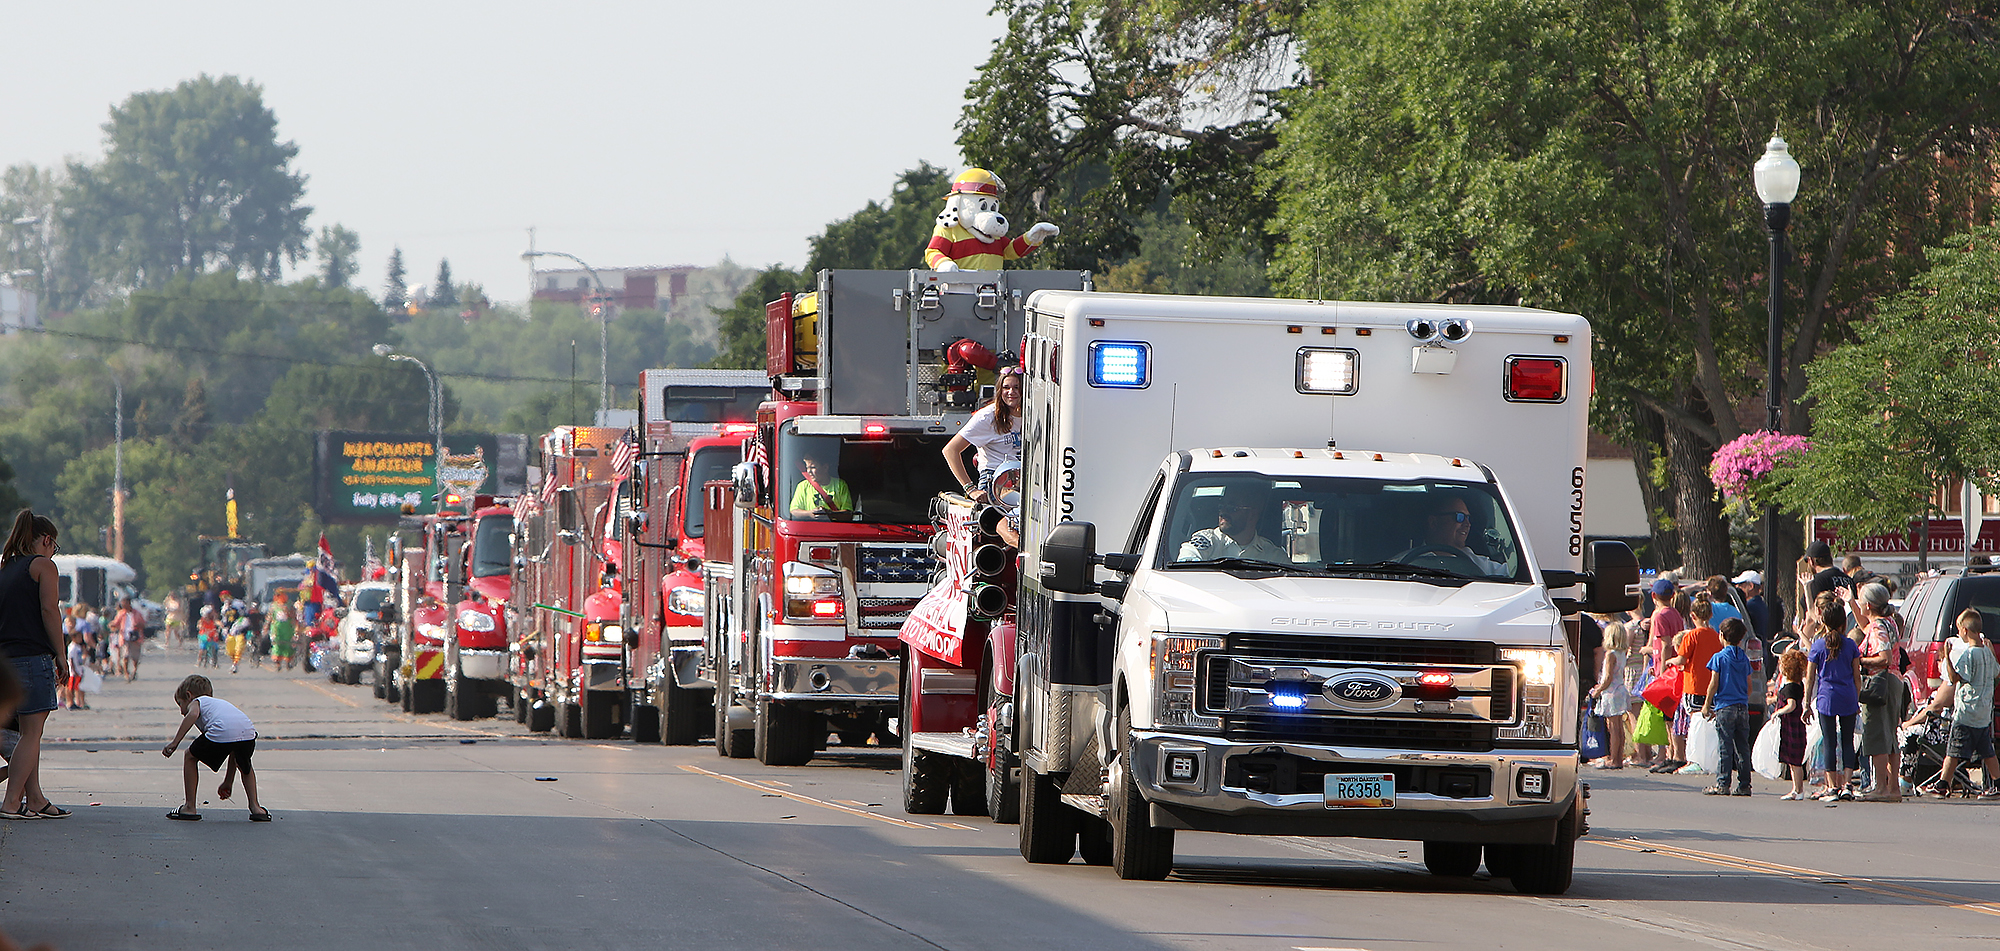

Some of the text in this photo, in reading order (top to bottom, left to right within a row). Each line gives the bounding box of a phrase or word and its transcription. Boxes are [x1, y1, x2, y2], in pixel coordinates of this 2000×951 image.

[352, 458, 423, 472] AMATEUR
[1568, 466, 1584, 556] 6358
[1817, 538, 1911, 551] UTHERAN
[1270, 616, 1455, 632] SUPER DUTY
[1343, 681, 1382, 699] Ford
[1339, 783, 1382, 799] R6358
